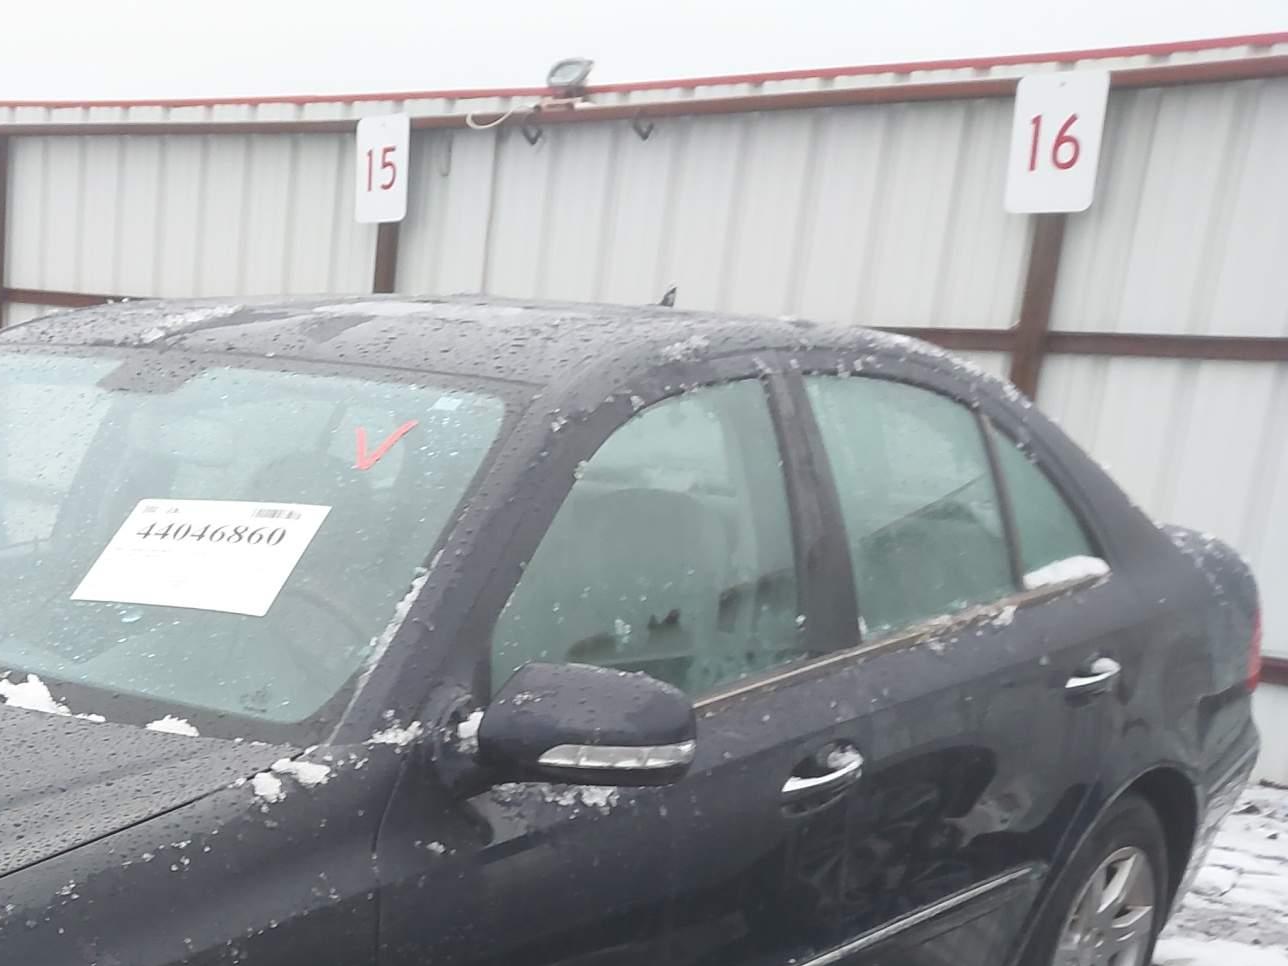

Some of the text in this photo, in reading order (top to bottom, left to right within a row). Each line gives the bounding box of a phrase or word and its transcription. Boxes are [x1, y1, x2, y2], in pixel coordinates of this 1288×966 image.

[1028, 113, 1081, 172] 16
[366, 145, 397, 192] 15
[136, 521, 287, 546] 44046860
